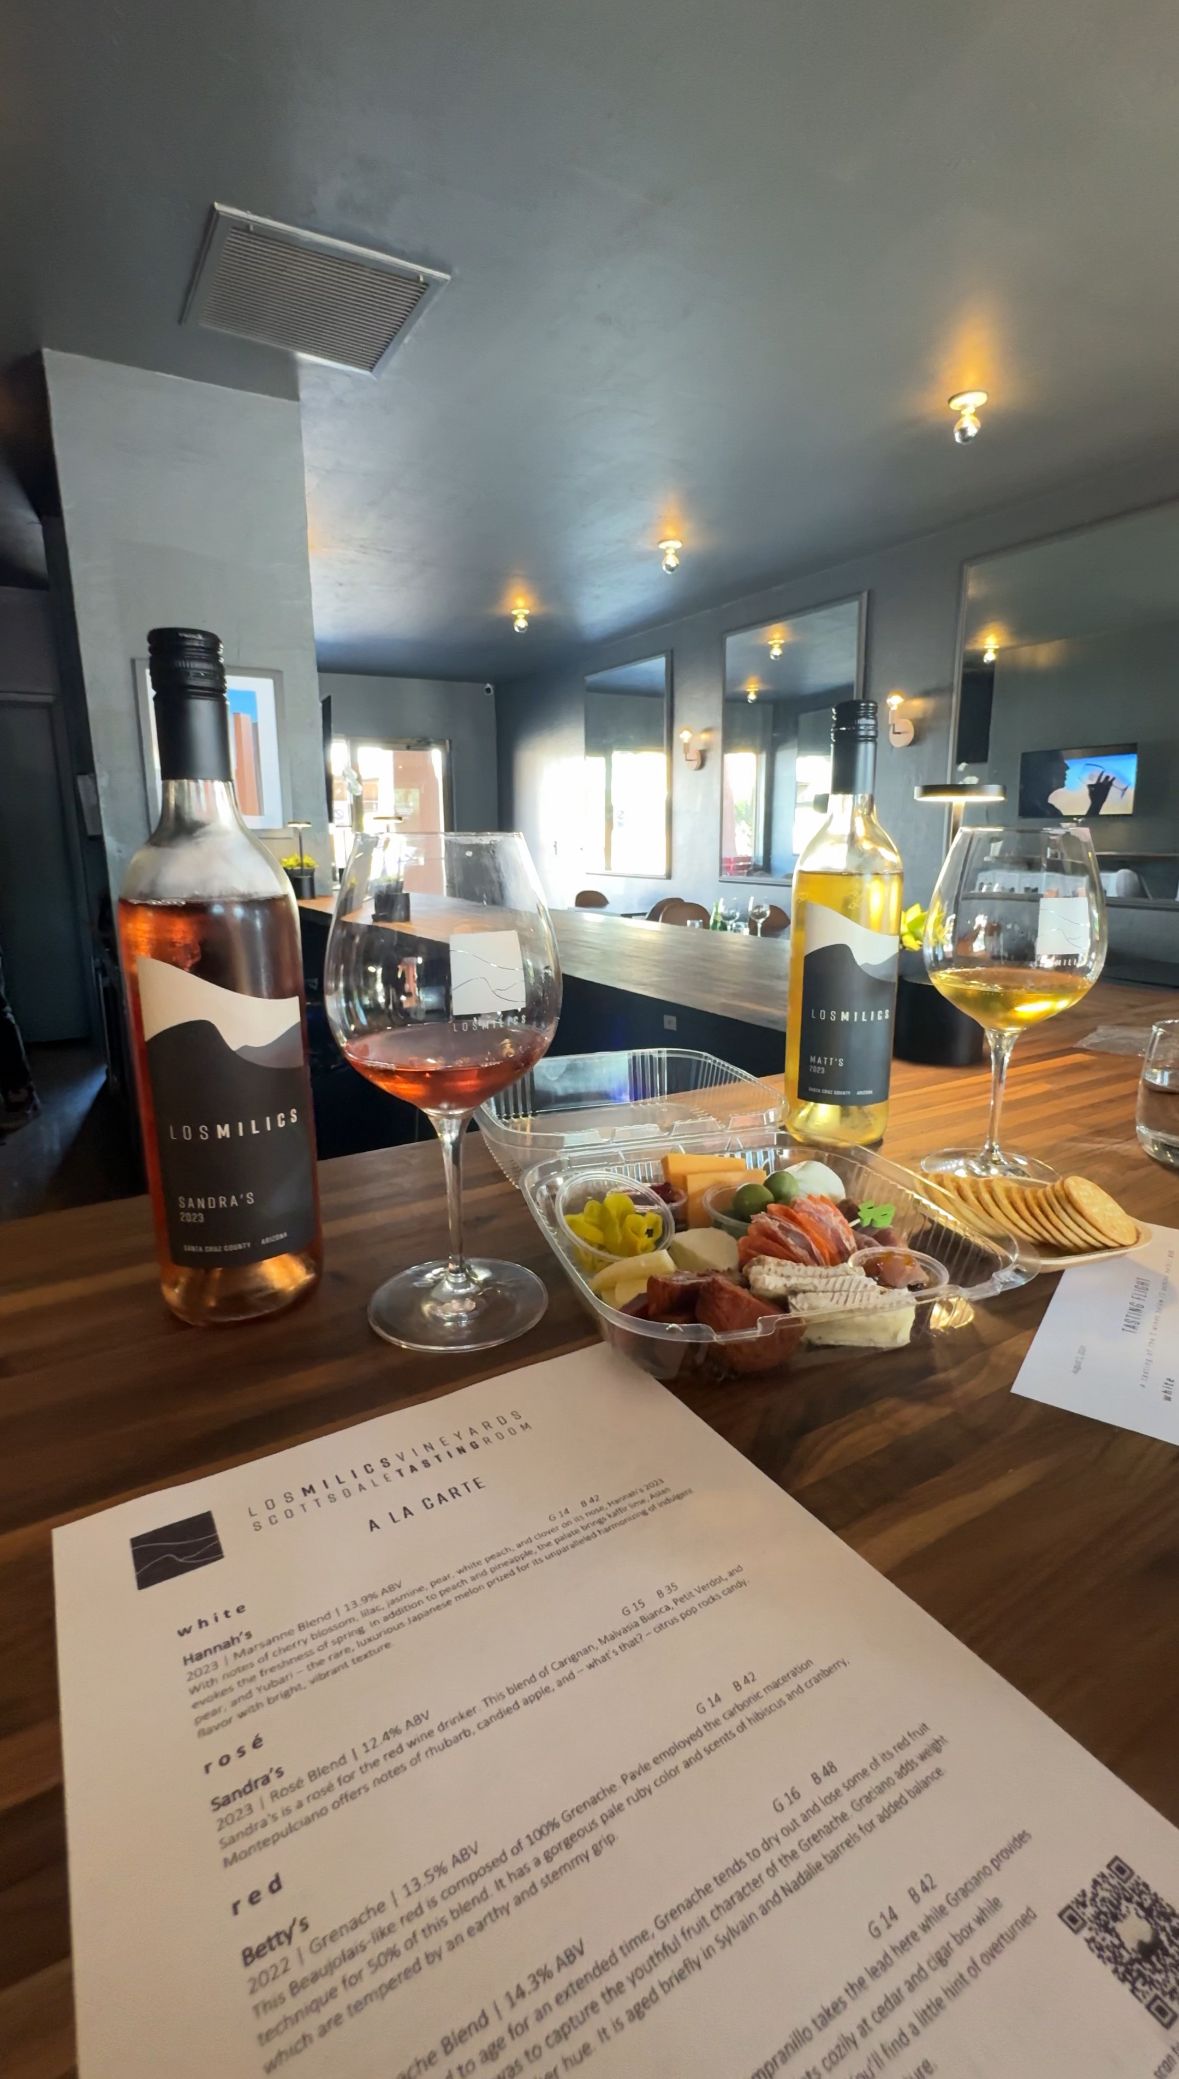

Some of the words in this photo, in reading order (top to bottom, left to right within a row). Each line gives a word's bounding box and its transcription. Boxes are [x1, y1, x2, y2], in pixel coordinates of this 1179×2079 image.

[811, 1009, 890, 1022] LOSMILICS
[809, 1065, 825, 1074] 2023
[810, 1056, 844, 1067] MATT'S
[169, 1108, 298, 1141] LOSMILICS
[178, 1192, 255, 1209] SANDRA'S
[180, 1212, 204, 1223] 2023
[1131, 1277, 1151, 1301] FLIGHT
[1121, 1301, 1145, 1334] TASTING
[368, 1518, 381, 1532] A
[388, 1505, 414, 1524] LA
[421, 1476, 487, 1510] CARTE
[176, 1604, 245, 1637] white
[621, 1605, 631, 1616] G
[632, 1598, 645, 1611] 15
[655, 1589, 664, 1599] B
[664, 1582, 678, 1594] 35
[182, 1630, 252, 1666] Hannah's
[186, 1661, 218, 1682] 2023
[233, 1629, 294, 1660] Marsanne
[297, 1611, 331, 1631] Blend
[344, 1591, 378, 1612] 13.9%
[380, 1580, 401, 1596] ABV
[219, 1813, 278, 1849] Sandra's
[281, 1806, 292, 1816] is
[295, 1799, 304, 1809] a
[306, 1782, 334, 1803] rosé
[336, 1770, 355, 1786] for
[358, 1758, 380, 1774] the
[382, 1743, 404, 1761] red
[406, 1729, 434, 1748] wine
[481, 1691, 505, 1707] This
[505, 1673, 537, 1695] blend
[538, 1665, 549, 1678] of
[597, 1620, 640, 1645] Malvasia
[727, 1564, 743, 1577] and
[695, 1701, 706, 1714] G
[706, 1692, 722, 1708] 14
[732, 1680, 742, 1692] B
[743, 1671, 756, 1685] 42
[203, 1733, 263, 1774] rosé
[223, 1806, 328, 1868] Montepulciano
[331, 1784, 369, 1810] offers
[372, 1763, 407, 1787] notes
[409, 1751, 421, 1767] of
[476, 1700, 520, 1730] candied
[556, 1670, 575, 1687] and
[585, 1649, 619, 1670] what's
[618, 1632, 643, 1652] that?
[652, 1616, 679, 1633] citrus
[679, 1606, 698, 1621] pop
[697, 1593, 722, 1608] rocks
[210, 1766, 284, 1812] Sandra's
[216, 1803, 253, 1831] 2023
[270, 1777, 304, 1802] Rosé
[307, 1753, 347, 1782] Blend
[362, 1725, 402, 1753] 12.4%
[405, 1709, 429, 1730] ABV
[772, 1797, 784, 1813] G
[783, 1785, 801, 1806] 16
[810, 1771, 822, 1785] B
[822, 1760, 837, 1777] 48
[252, 1993, 285, 2018] This
[289, 1922, 395, 1996] Beaujolais-like
[399, 1901, 424, 1925] red
[426, 1896, 438, 1909] is
[440, 1849, 508, 1900] composed
[510, 1838, 523, 1856] of
[525, 1817, 560, 1846] 100%
[652, 1726, 703, 1765] employed
[702, 1718, 721, 1732] the
[722, 1691, 763, 1720] carbonic
[763, 1659, 813, 1694] maceration
[231, 1872, 282, 1916] red
[248, 1957, 290, 1995] 2022
[309, 1901, 385, 1953] Grenache
[402, 1861, 448, 1897] 13.5%
[451, 1840, 478, 1868] ABV
[456, 2059, 476, 2079] to
[479, 2036, 506, 2063] age
[507, 2016, 529, 2040] for
[534, 2002, 552, 2022] an
[555, 1949, 618, 2005] extended
[653, 1883, 713, 1930] Grenache
[712, 1858, 747, 1886] tends
[745, 1847, 761, 1862] to
[760, 1833, 781, 1852] dry
[780, 1818, 800, 1837] out
[800, 1800, 821, 1823] and
[817, 1788, 842, 1806] lose
[842, 1767, 870, 1791] some
[869, 1755, 880, 1771] of
[878, 1750, 894, 1762] its
[892, 1735, 911, 1753] red
[906, 1722, 930, 1741] fruit
[523, 2044, 542, 2063] to
[545, 2001, 599, 2048] capture
[600, 1981, 625, 2004] the
[626, 1935, 681, 1987] youthful
[680, 1915, 710, 1941] fruit
[710, 1873, 764, 1920] character
[765, 1859, 779, 1878] of
[777, 1849, 799, 1867] the
[850, 1776, 895, 1811] Graciano
[894, 1759, 918, 1779] adds
[917, 1735, 948, 1761] weight
[867, 1919, 882, 1939] G
[879, 1905, 898, 1930] 14
[907, 1886, 920, 1904] B
[919, 1873, 937, 1893] 42
[241, 1916, 309, 1967] Betty's
[811, 1996, 847, 2031] takes
[843, 1975, 868, 2000] the
[864, 1950, 894, 1980] lead
[889, 1930, 920, 1957] here
[918, 1904, 949, 1933] while
[945, 1865, 992, 1907] Graciano
[990, 1829, 1032, 1871] provides
[263, 2033, 313, 2074] which
[318, 2012, 343, 2038] are
[347, 1957, 422, 2016] tempered
[424, 1946, 442, 1965] by
[446, 1933, 464, 1952] an
[466, 1902, 510, 1937] earthy
[513, 1881, 538, 1906] and
[540, 1850, 589, 1888] stemmy
[440, 2009, 489, 2056] Blend
[505, 1963, 553, 2008] 14.3%
[555, 1937, 584, 1972] ABV
